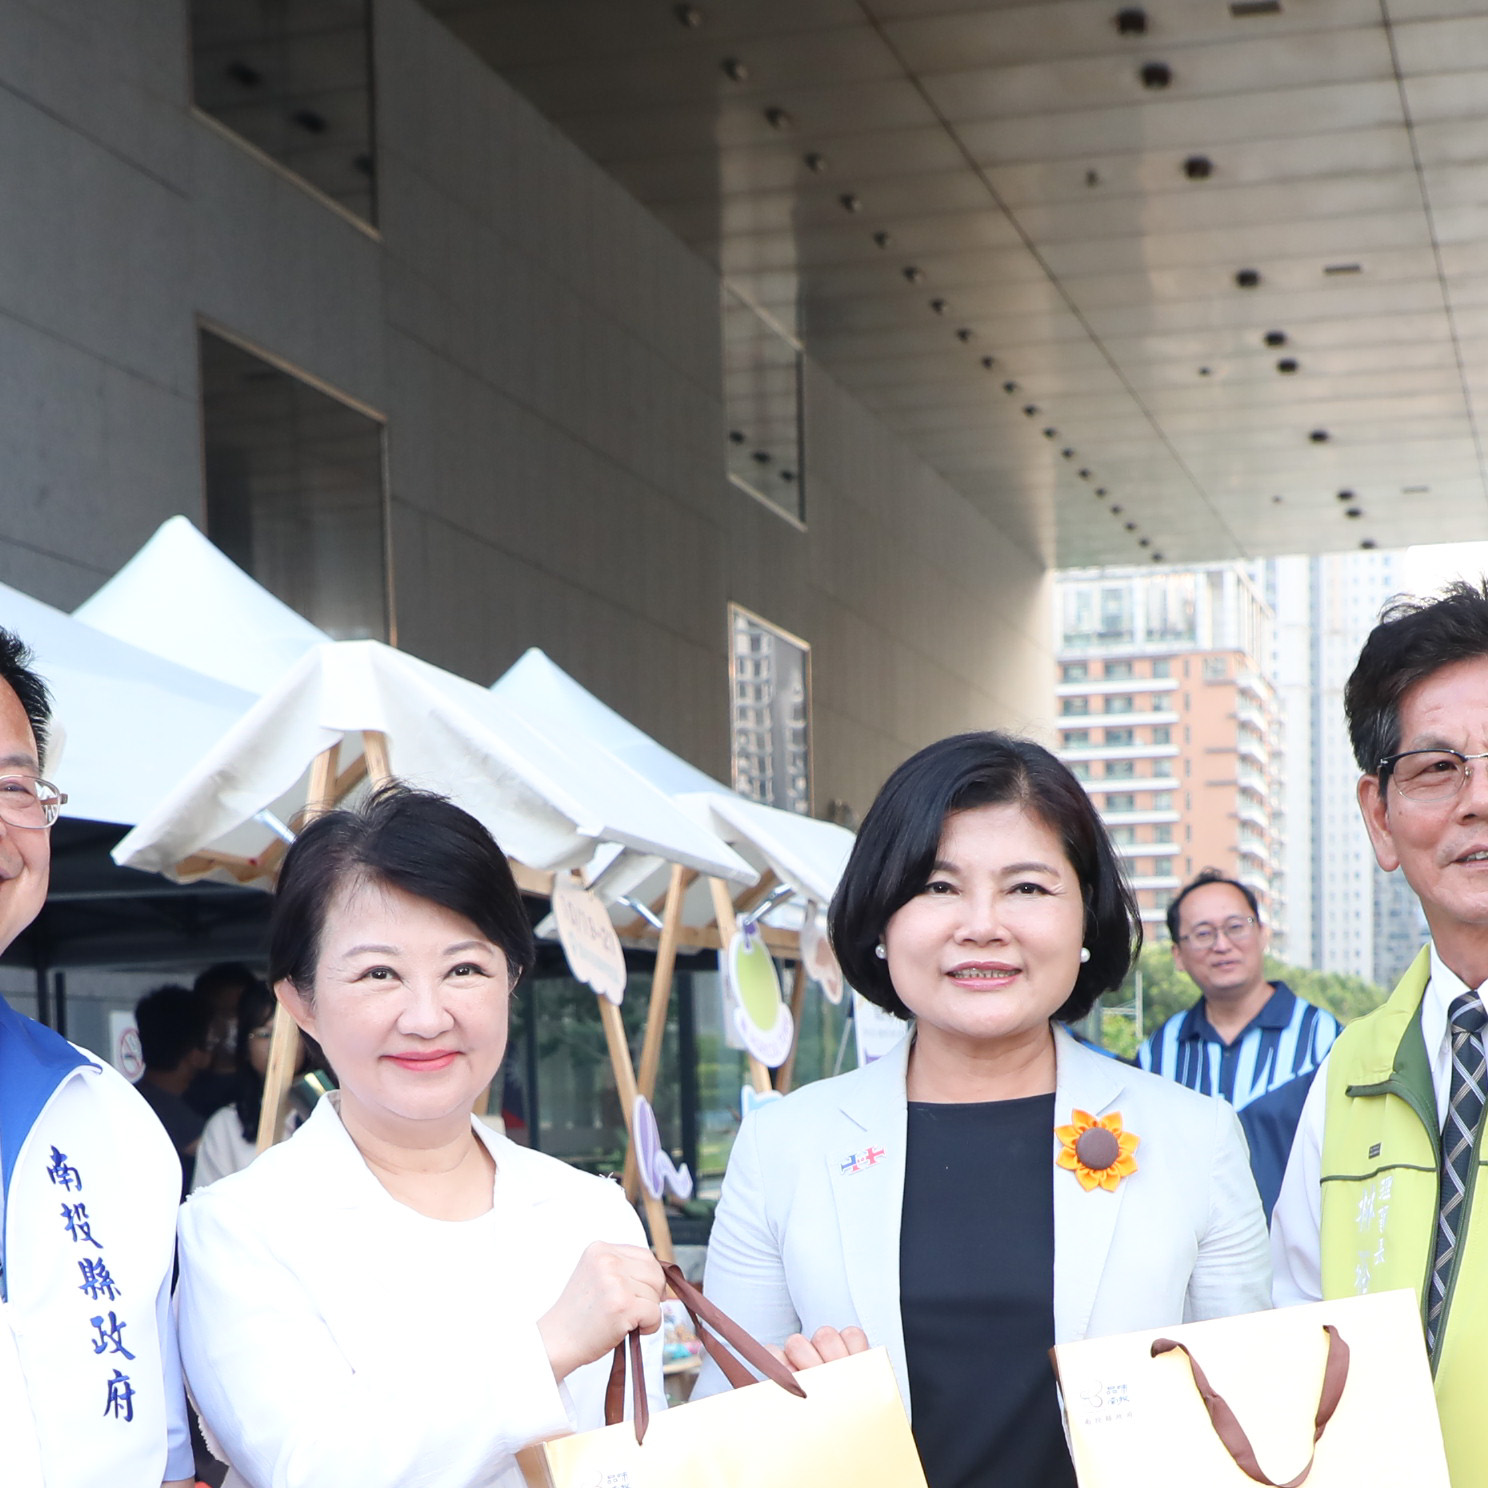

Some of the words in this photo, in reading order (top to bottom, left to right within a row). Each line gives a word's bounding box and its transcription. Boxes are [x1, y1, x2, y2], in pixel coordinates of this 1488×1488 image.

[45, 1144, 137, 1424] 南投縣政府
